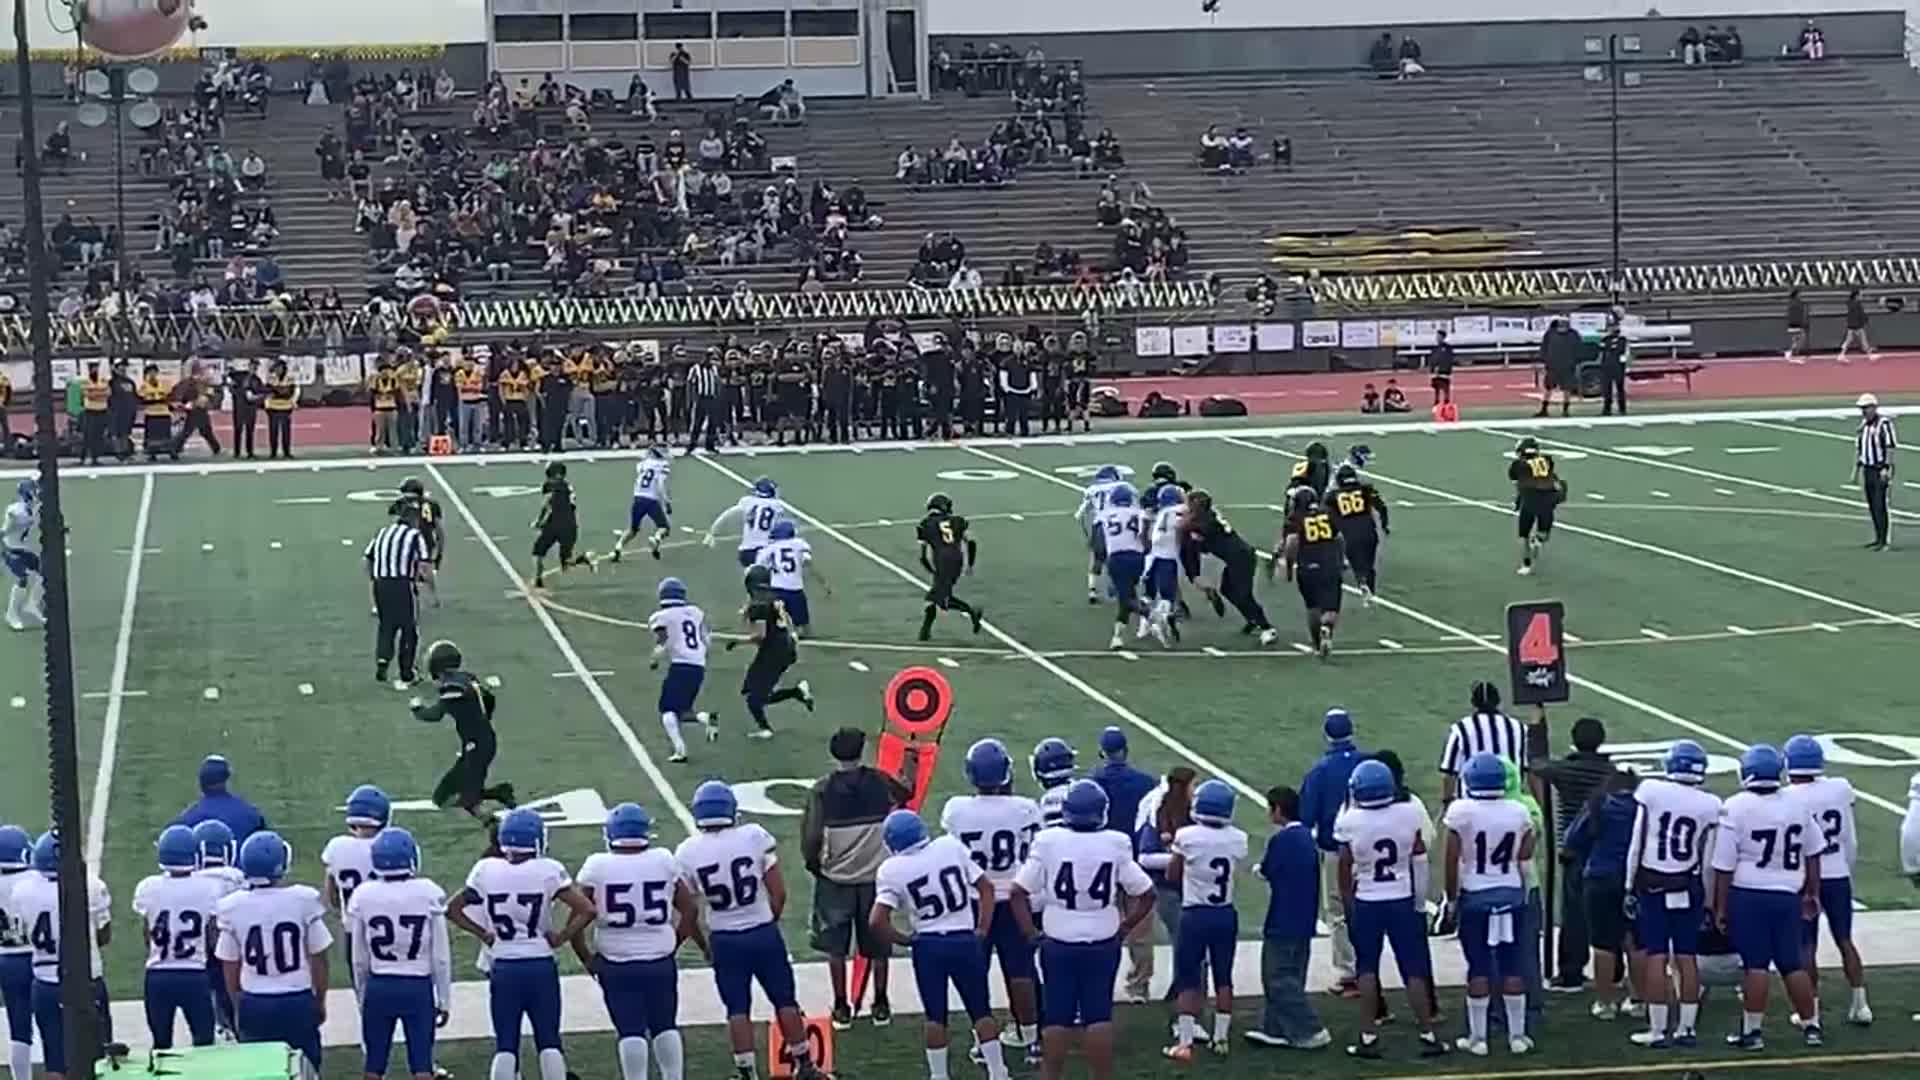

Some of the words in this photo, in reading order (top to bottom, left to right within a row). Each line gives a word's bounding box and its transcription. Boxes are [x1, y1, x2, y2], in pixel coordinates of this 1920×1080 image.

[1527, 457, 1549, 477] 10
[1107, 513, 1140, 538] 54
[1337, 490, 1365, 515] 66
[938, 520, 955, 544] 5
[1304, 513, 1333, 542] 65
[1519, 612, 1559, 665] 4
[960, 829, 1016, 871] 58
[1475, 830, 1516, 875] 14
[1657, 811, 1697, 861] 10
[1751, 824, 1803, 871] 76
[1812, 809, 1842, 855] 2
[696, 856, 758, 911] 56
[1207, 857, 1231, 904] 3
[1373, 838, 1398, 882] 2
[605, 881, 669, 928] 55
[907, 865, 967, 921] 50
[1054, 861, 1114, 910] 44
[152, 909, 203, 961] 42
[368, 915, 428, 962] 27
[487, 893, 545, 940] 57
[245, 921, 301, 976] 40
